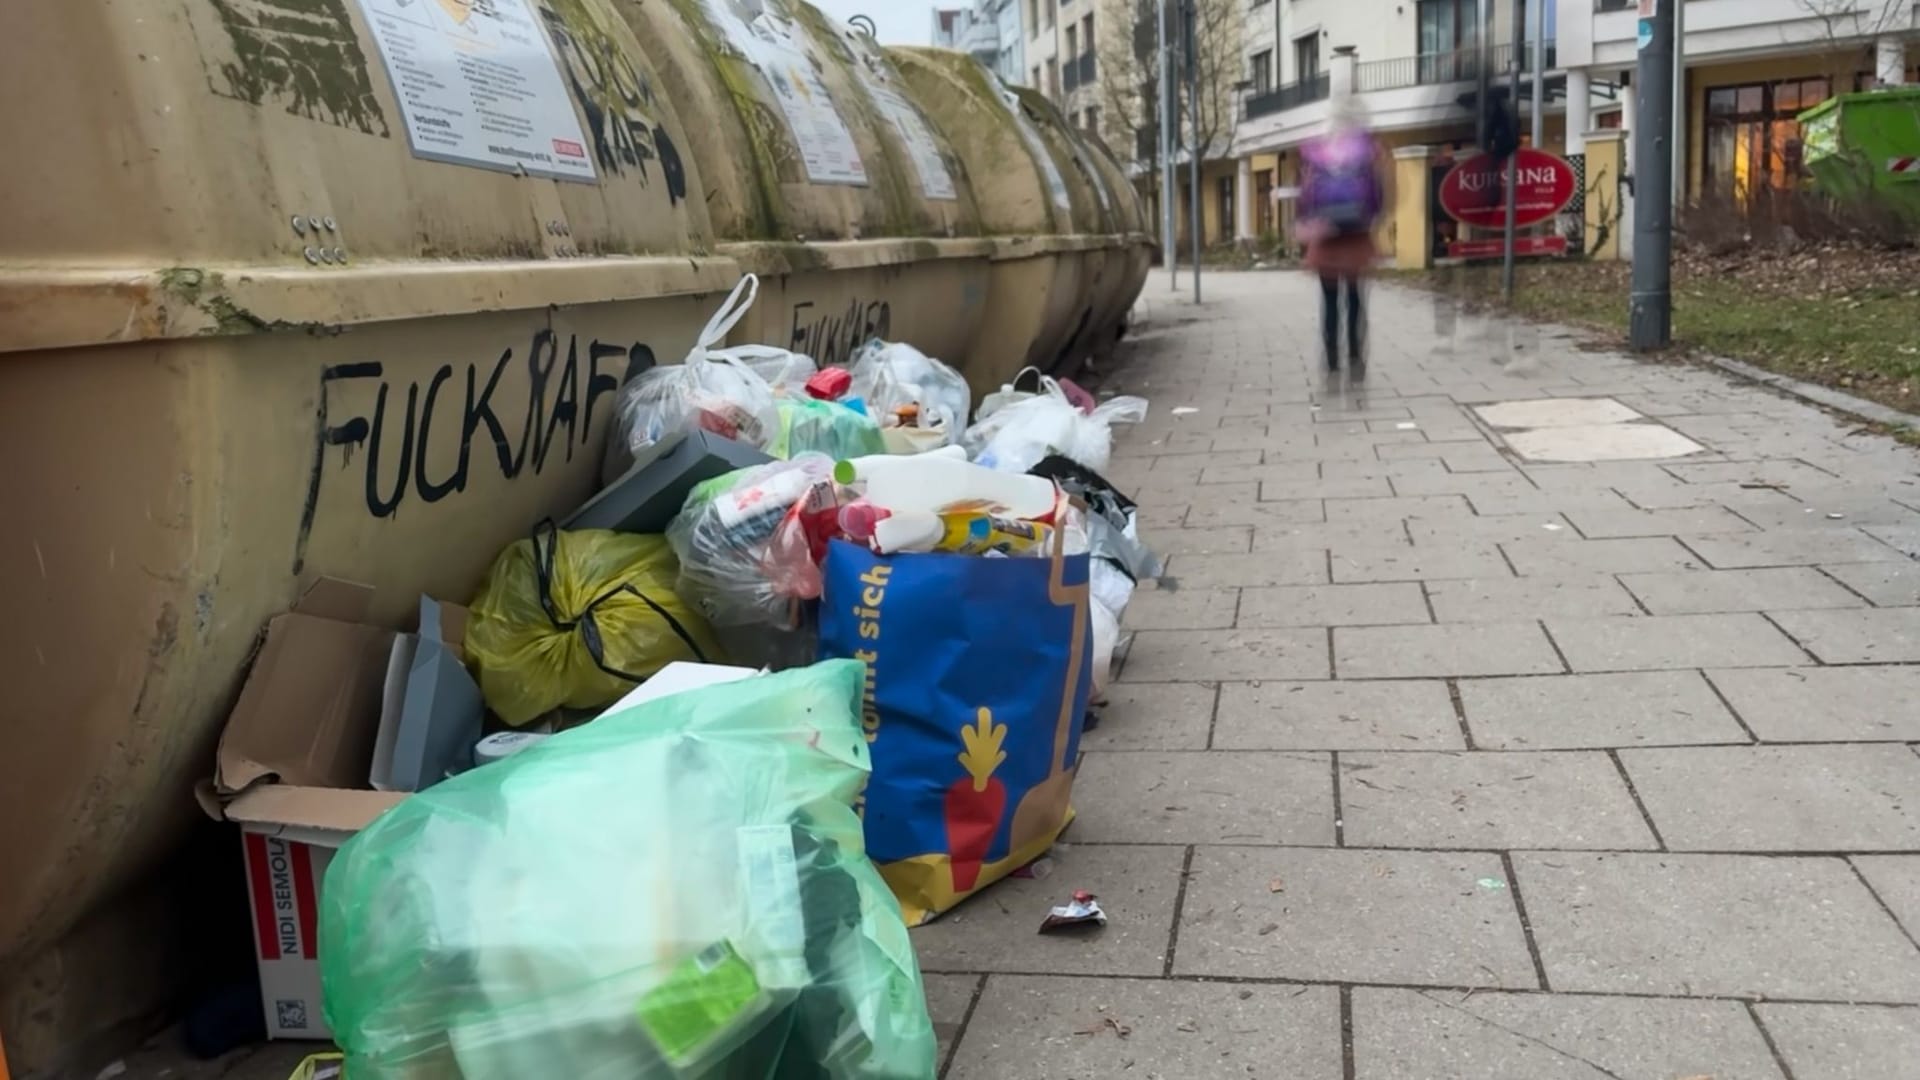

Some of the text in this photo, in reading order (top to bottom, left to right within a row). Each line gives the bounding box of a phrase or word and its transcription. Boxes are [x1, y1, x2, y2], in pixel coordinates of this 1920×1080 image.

[292, 347, 513, 576] FUCK
[853, 564, 893, 640] sich
[279, 916, 298, 955] NIDI
